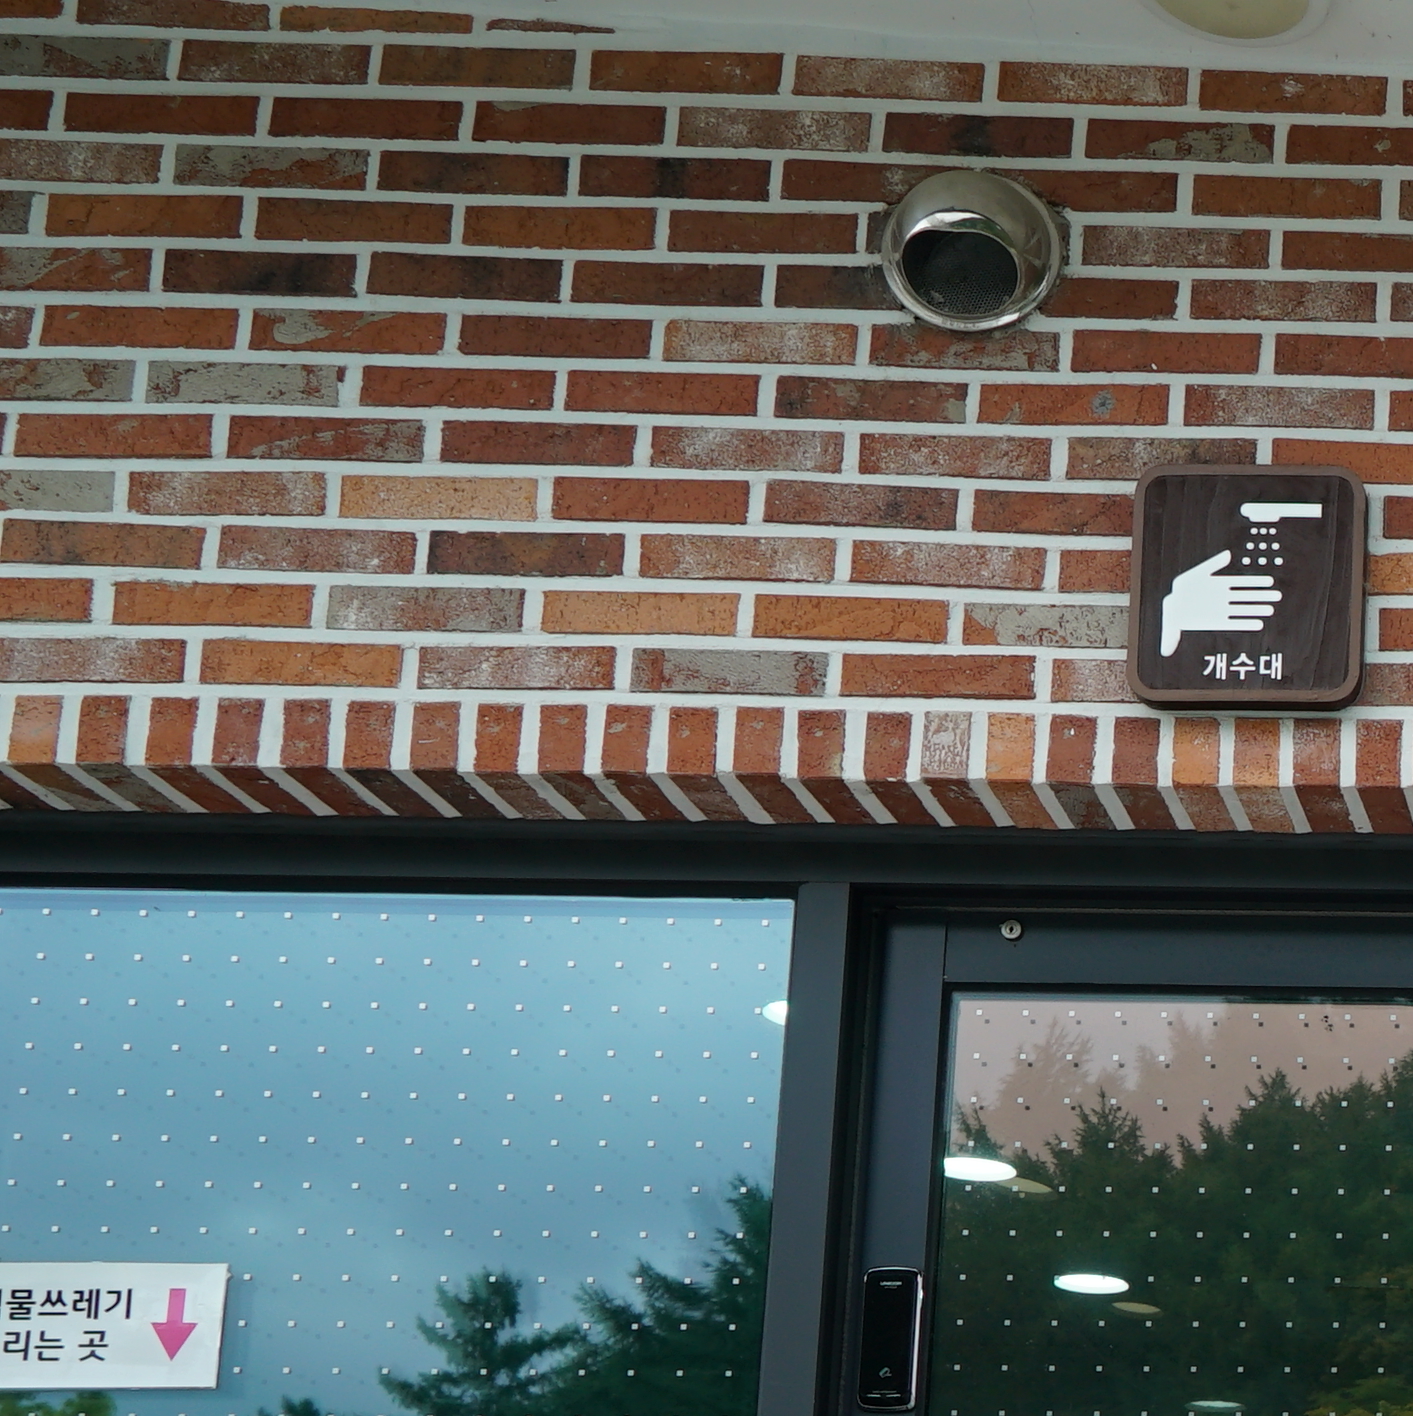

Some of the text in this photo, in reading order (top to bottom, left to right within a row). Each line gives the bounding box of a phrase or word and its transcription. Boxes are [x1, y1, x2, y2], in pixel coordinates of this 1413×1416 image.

[1202, 653, 1283, 680] 개수대
[0, 1288, 133, 1320] 물쓰레기
[3, 1330, 109, 1361] 리는 곳
